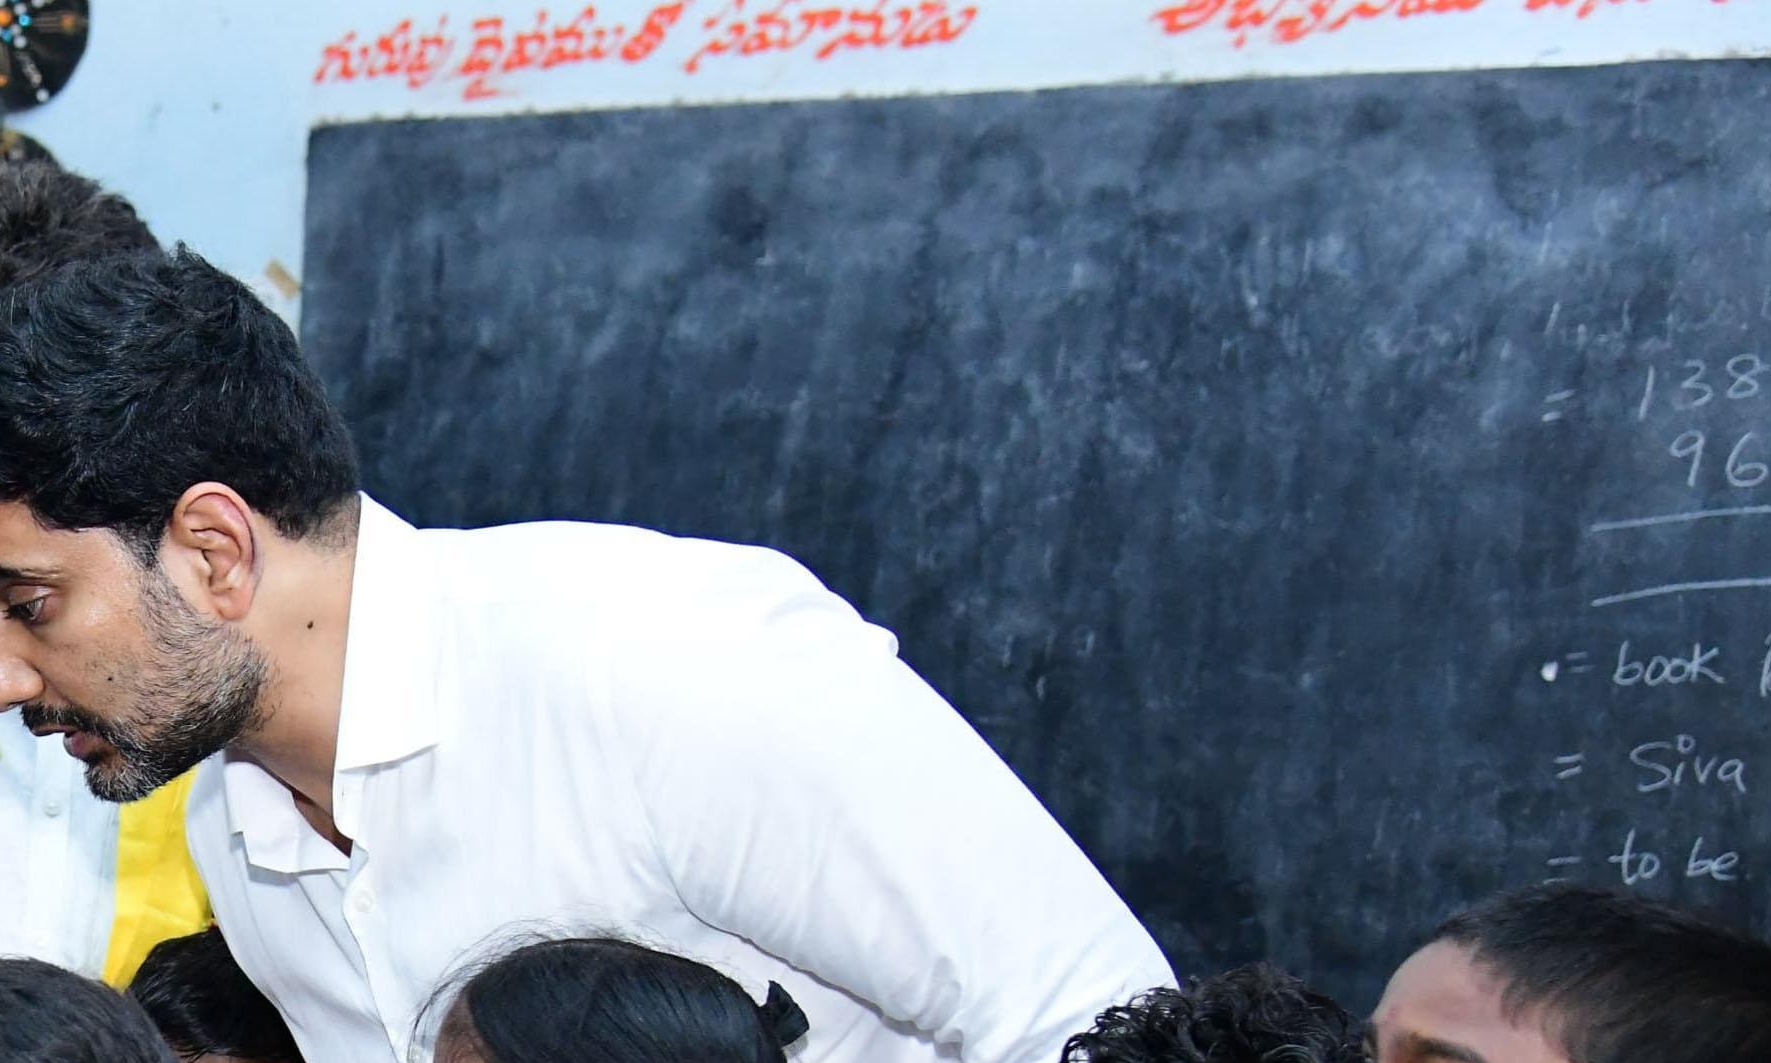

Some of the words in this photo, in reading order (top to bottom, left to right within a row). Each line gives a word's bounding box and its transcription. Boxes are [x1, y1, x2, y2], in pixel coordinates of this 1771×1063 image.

[1613, 640, 1725, 686] book
[1630, 734, 1747, 792] Siva
[1607, 829, 1661, 886] to
[1685, 837, 1740, 881] be
